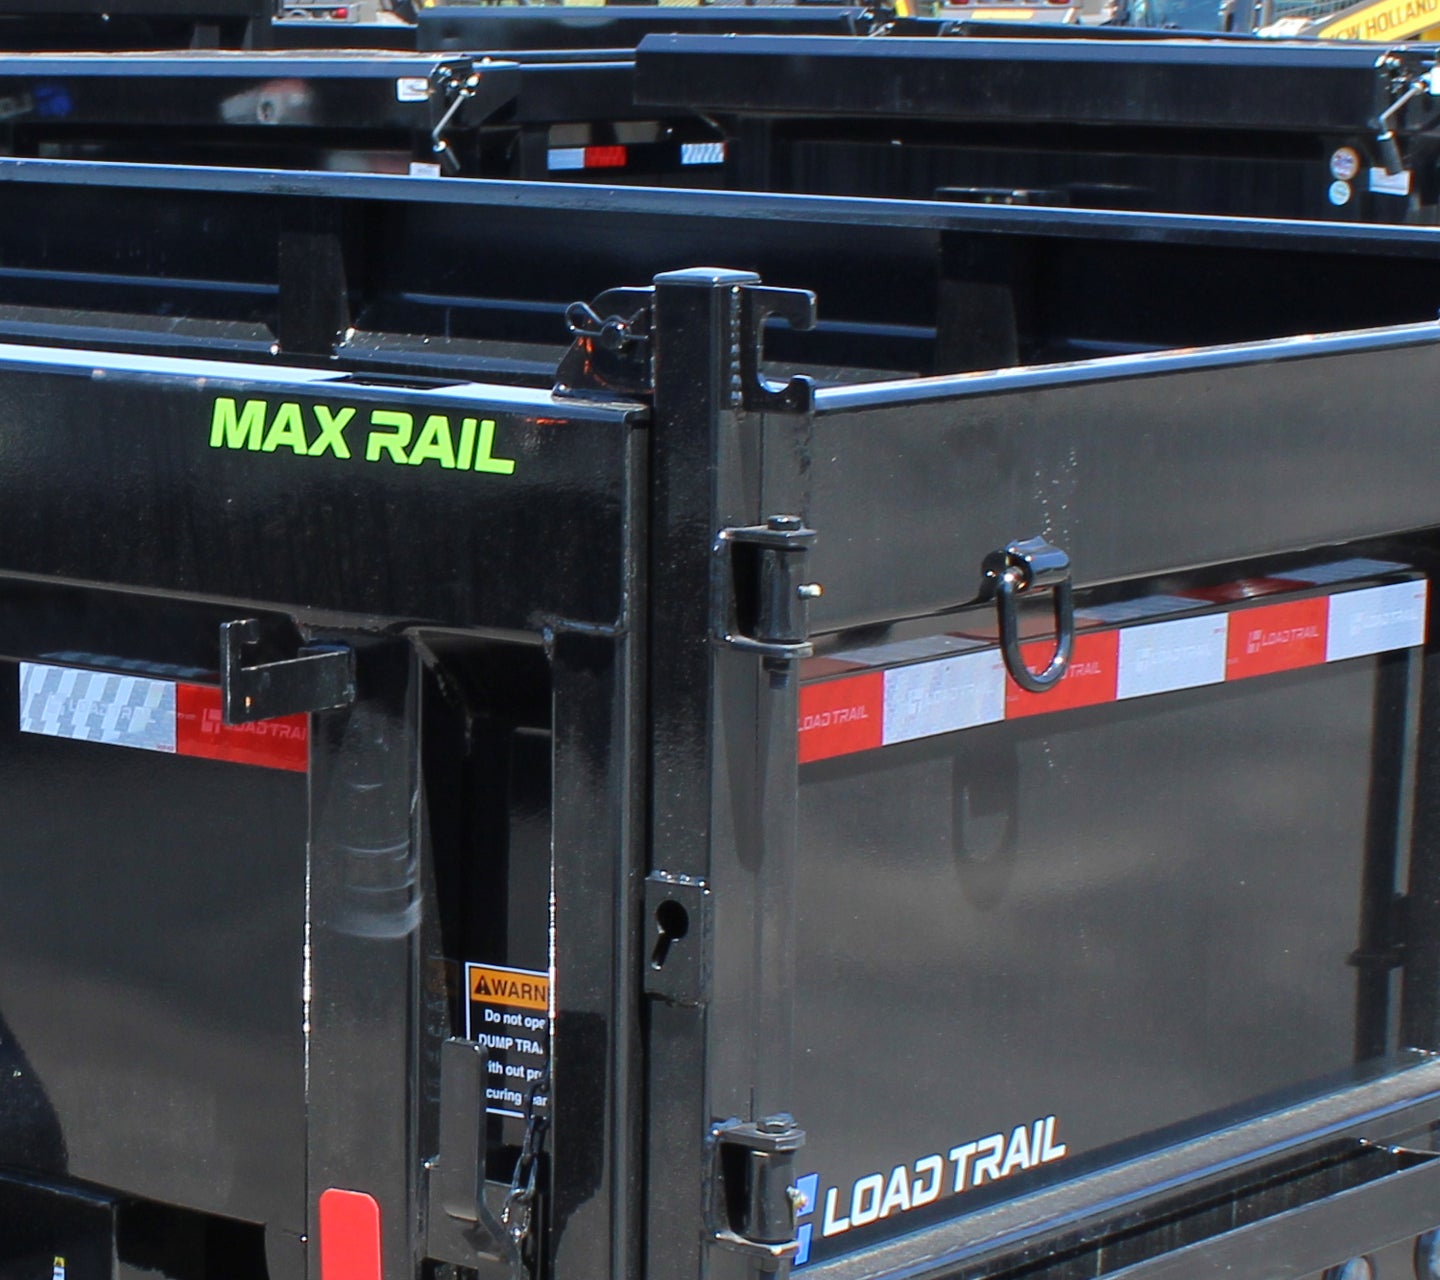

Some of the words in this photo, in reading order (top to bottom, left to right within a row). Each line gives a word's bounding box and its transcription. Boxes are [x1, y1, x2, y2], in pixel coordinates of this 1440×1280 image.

[1331, 22, 1363, 40] EW
[209, 396, 357, 460] MAX
[365, 409, 517, 476] RAIL
[1262, 631, 1291, 647] LOAD
[1289, 624, 1320, 641] TRAIL
[832, 705, 869, 725] TRAIL
[485, 1008, 501, 1023] Do
[502, 1012, 523, 1028] not
[479, 1033, 514, 1050] DUMP
[515, 1038, 544, 1056] TRA
[506, 1063, 525, 1079] out
[822, 1153, 944, 1238] LOAD
[948, 1114, 1067, 1193] TRAIL
